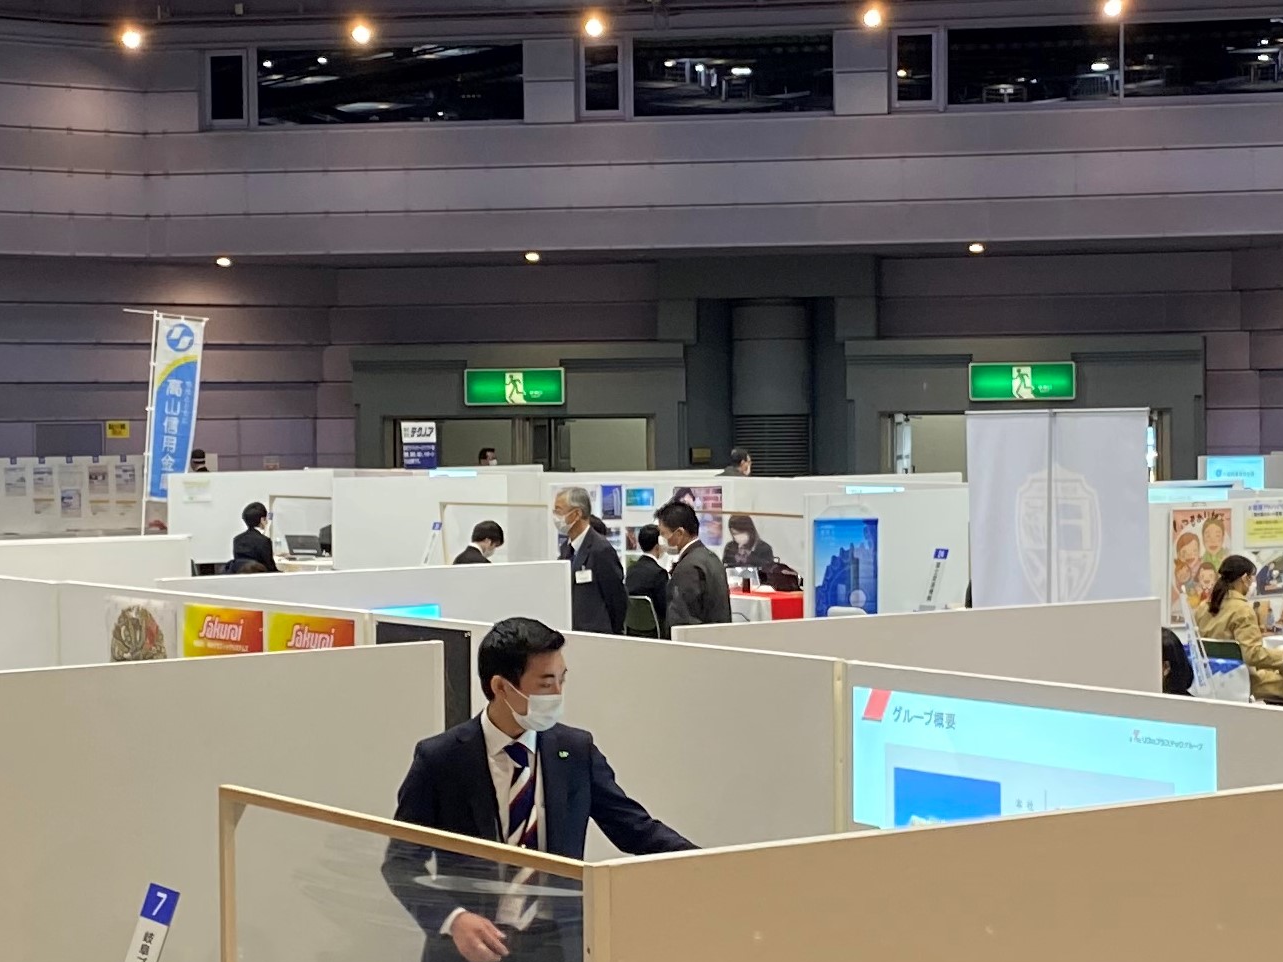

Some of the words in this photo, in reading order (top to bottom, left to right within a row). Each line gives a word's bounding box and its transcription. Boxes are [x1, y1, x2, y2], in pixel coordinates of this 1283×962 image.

[198, 613, 245, 642] Sakurai
[287, 621, 336, 649] Sakurai
[892, 704, 957, 730] グループ概要
[151, 891, 168, 916] 7
